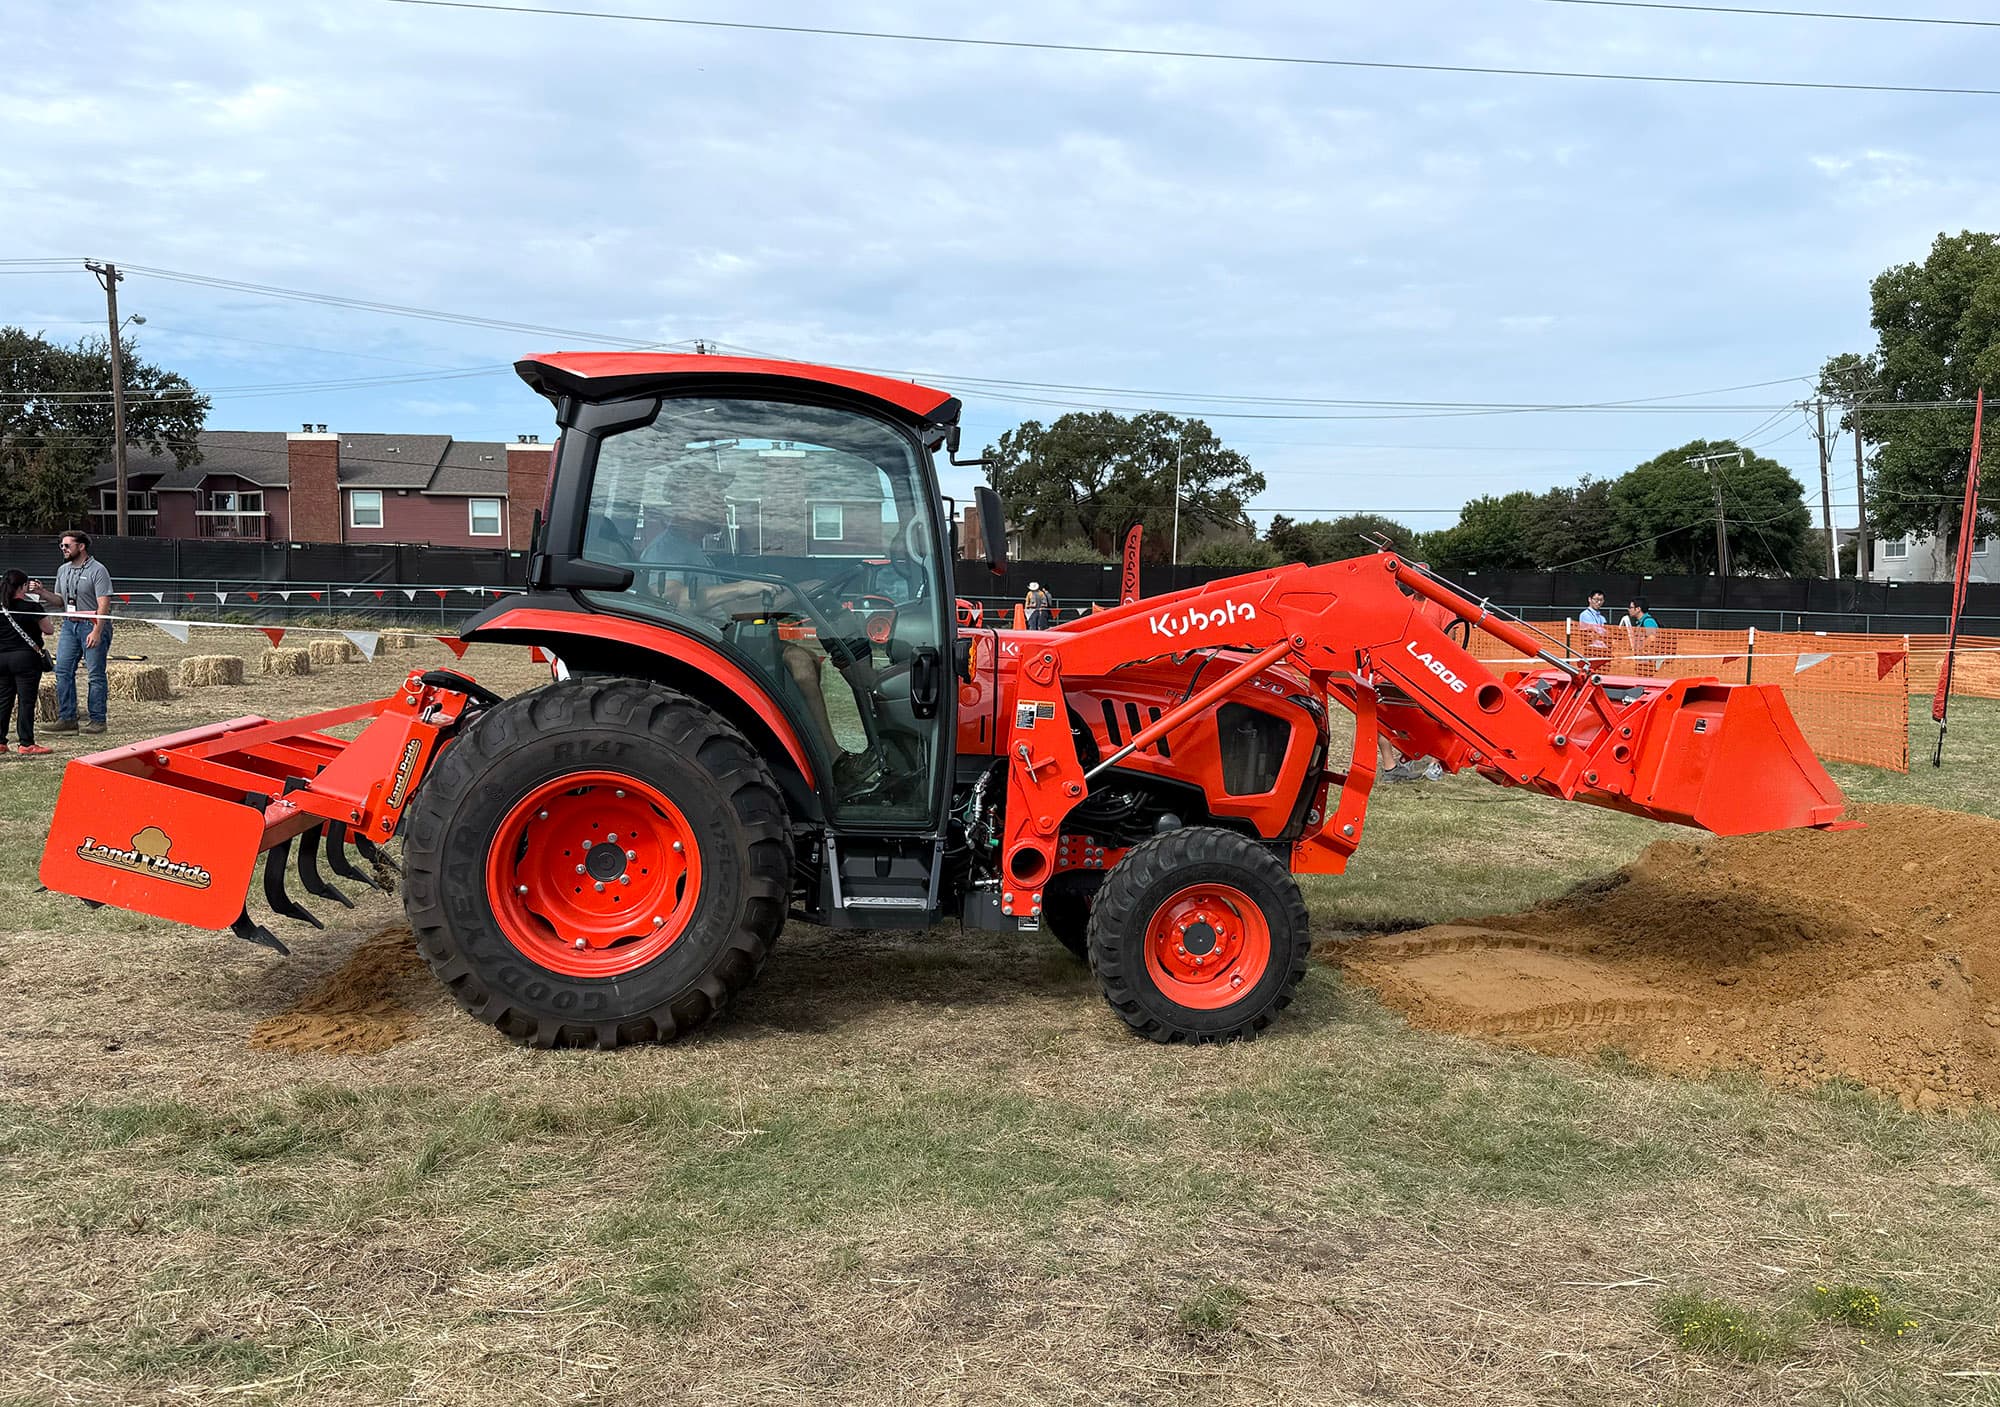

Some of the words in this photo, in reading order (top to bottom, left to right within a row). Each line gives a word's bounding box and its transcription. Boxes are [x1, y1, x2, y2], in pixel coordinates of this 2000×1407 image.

[1125, 534, 1137, 593] Kubota
[1149, 599, 1256, 638] Kubota
[1406, 641, 1468, 693] LA806
[387, 774, 405, 808] Land
[400, 739, 419, 772] Pride
[78, 837, 140, 867] Land
[148, 855, 210, 885] Pride
